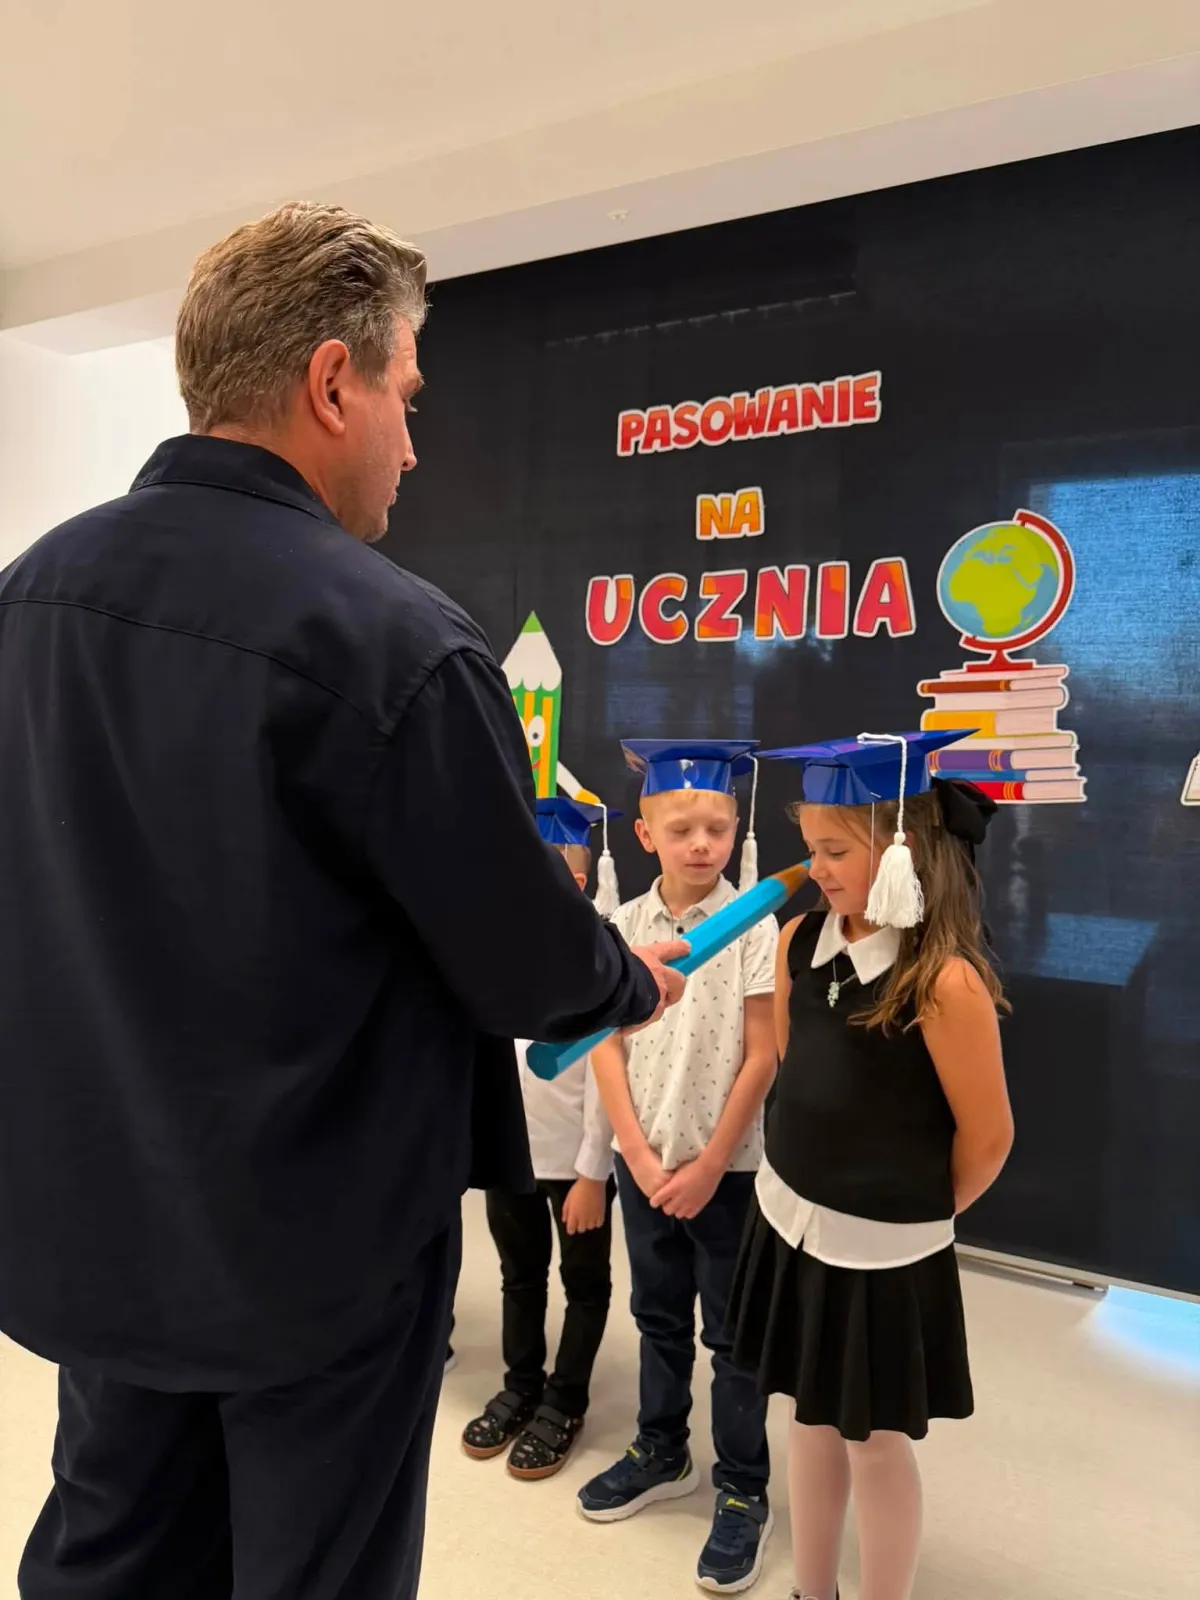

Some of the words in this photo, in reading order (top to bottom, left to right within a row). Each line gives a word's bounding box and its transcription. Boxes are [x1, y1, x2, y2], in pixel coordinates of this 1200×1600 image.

[618, 372, 880, 455] PASOWANIE
[698, 489, 763, 538] NA
[587, 559, 914, 643] UCZNIA
